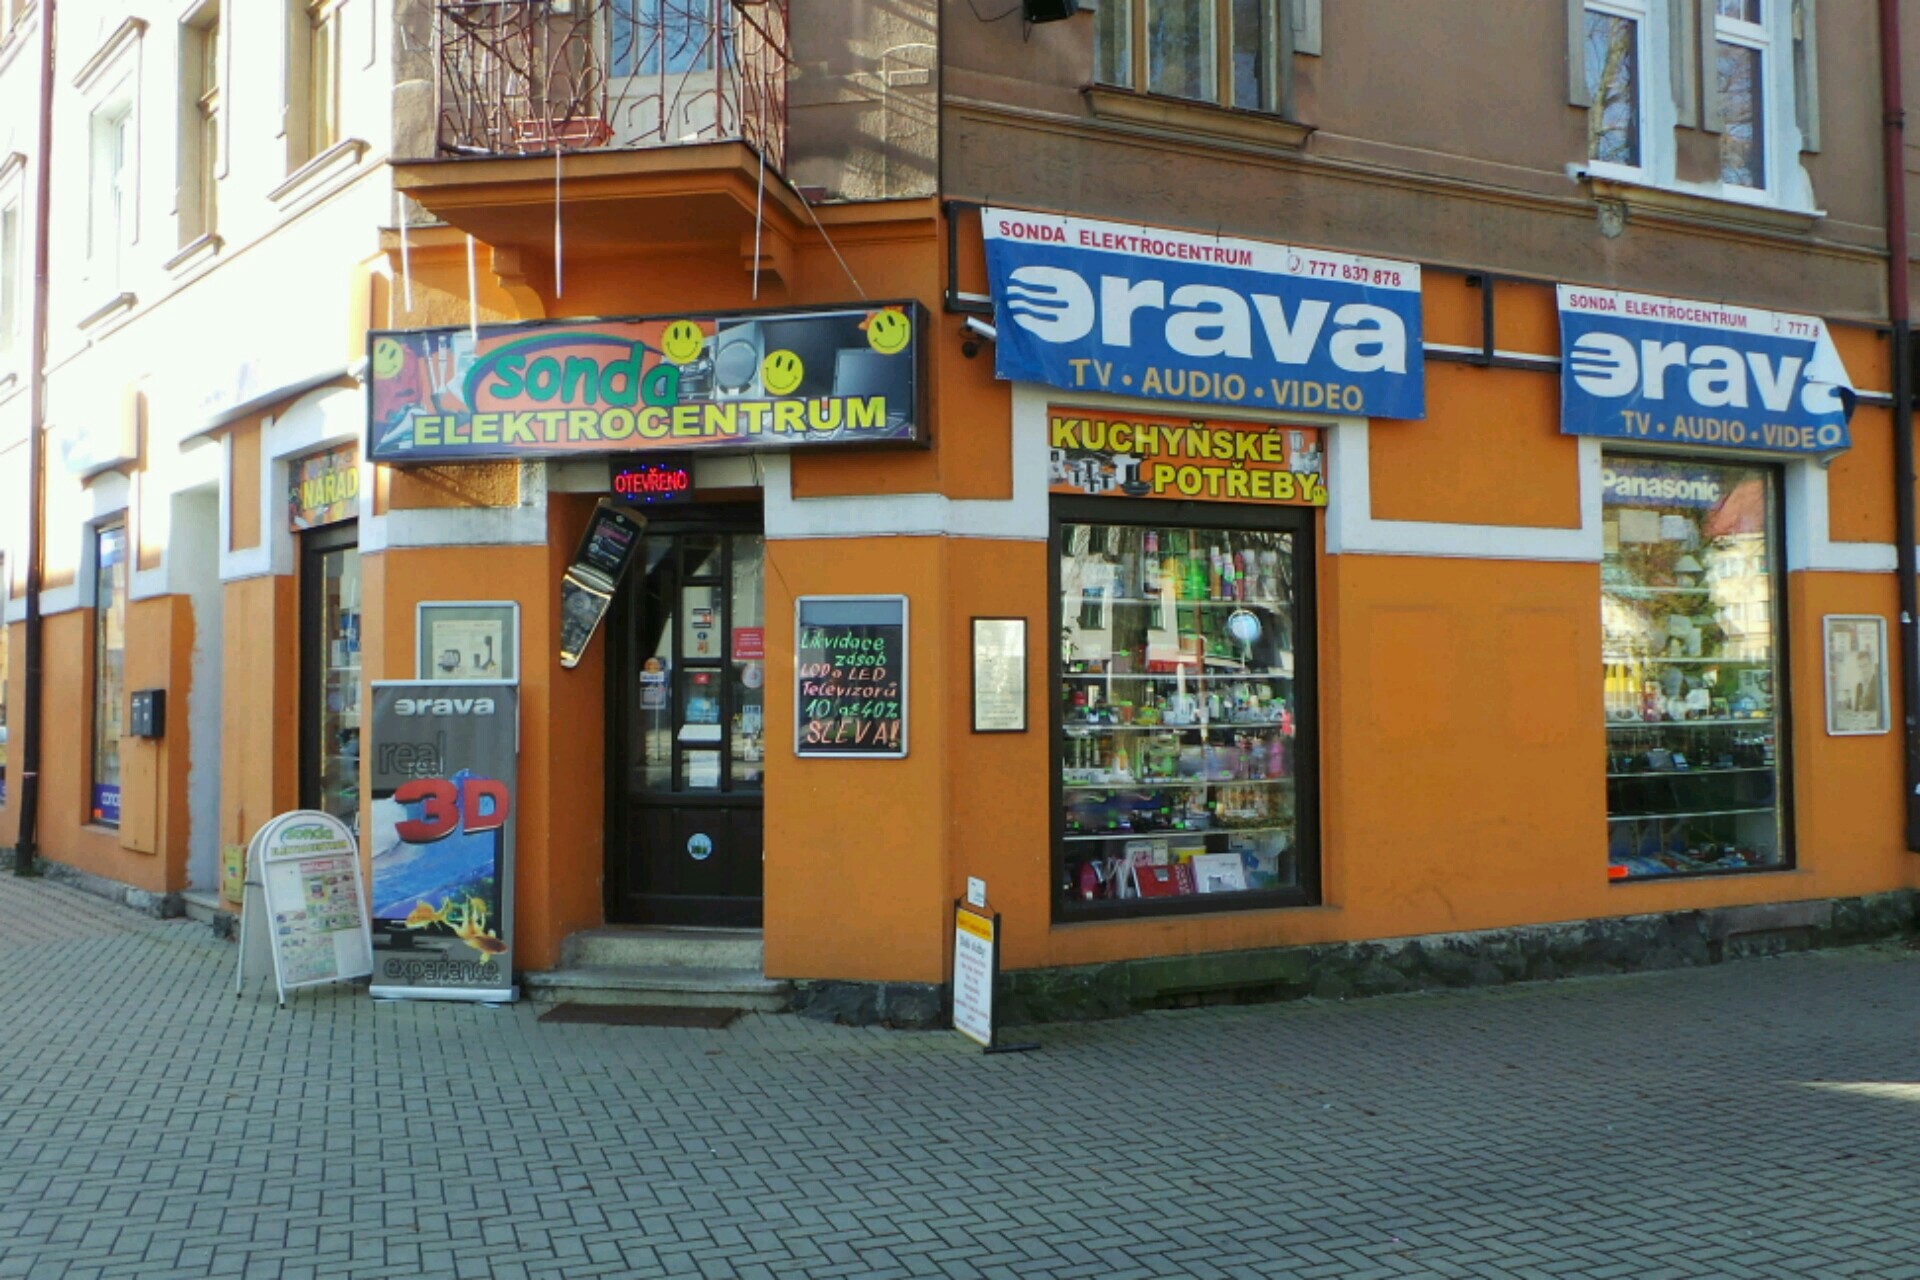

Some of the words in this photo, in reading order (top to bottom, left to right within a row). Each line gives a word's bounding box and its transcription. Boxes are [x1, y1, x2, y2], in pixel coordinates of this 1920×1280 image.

[999, 220, 1066, 243] SONDA
[1079, 230, 1253, 267] ELEKTROCENTRUM
[1309, 260, 1337, 277] 777
[1373, 269, 1401, 287] 878
[1569, 293, 1617, 311] SONDA
[1625, 300, 1747, 328] ELEKTROCENTRUM
[489, 341, 679, 407] sonda
[1069, 359, 1113, 387] TV
[1142, 366, 1246, 401] AUDIO
[1271, 378, 1364, 411] VIDEO
[413, 396, 887, 447] ELEKTROCENTRUM
[1051, 417, 1283, 462] KUCHYŇSKÉ
[1621, 410, 1651, 435] TV
[1672, 415, 1746, 442] AUDIO
[1762, 424, 1842, 449] VIDEO
[614, 467, 688, 493] OTEVŘENO
[1153, 462, 1320, 500] POTŘEBY
[1601, 467, 1721, 502] Panasonic
[848, 666, 886, 681] LED
[805, 699, 831, 718] 10
[378, 730, 447, 775] real
[394, 777, 509, 845] 3D
